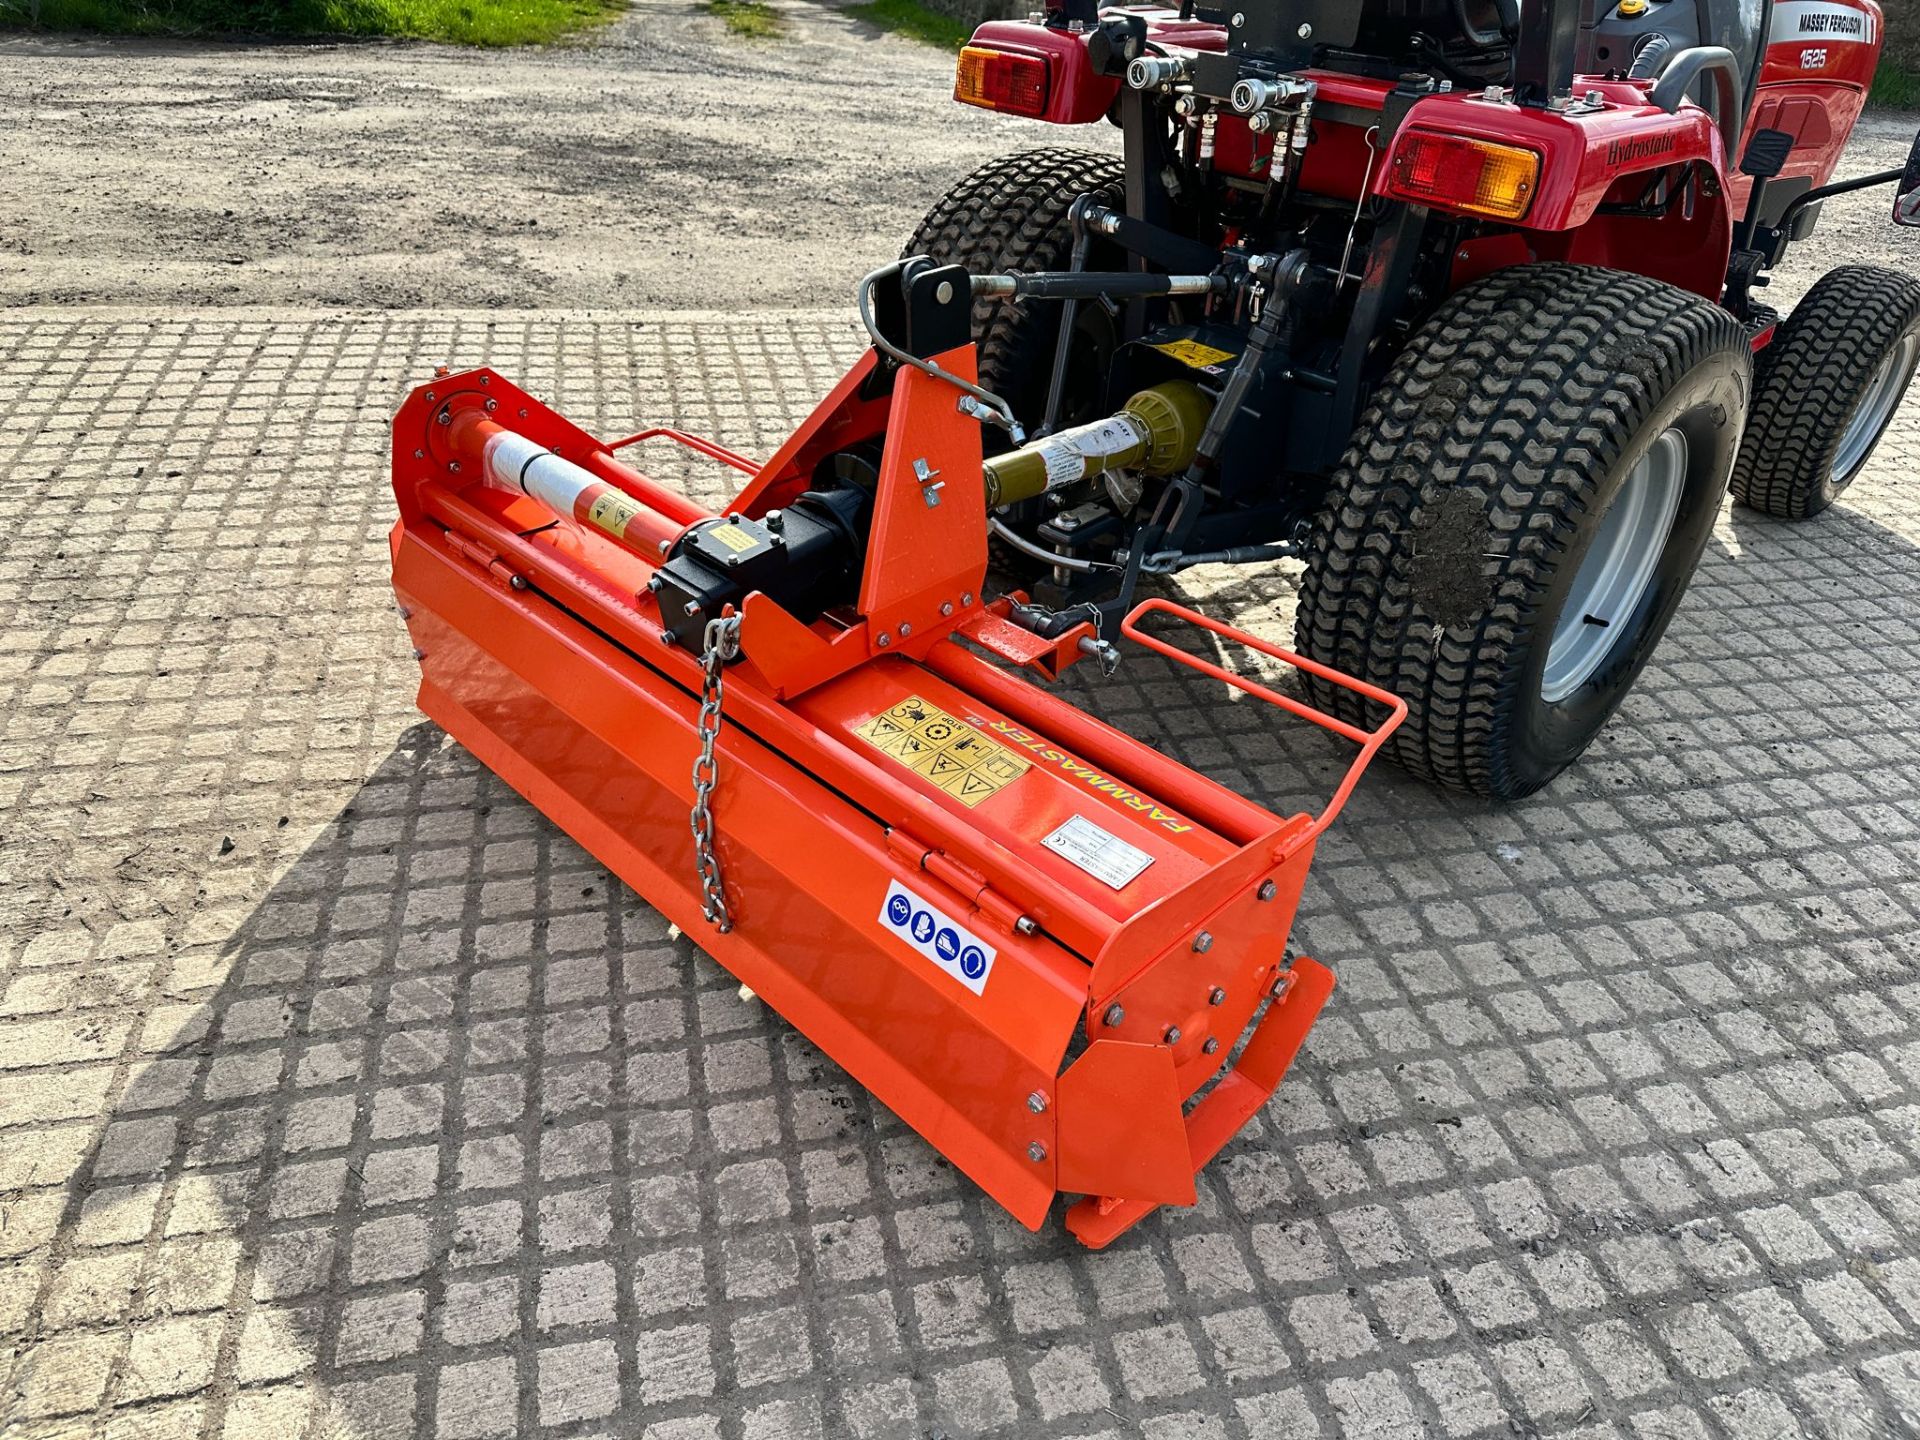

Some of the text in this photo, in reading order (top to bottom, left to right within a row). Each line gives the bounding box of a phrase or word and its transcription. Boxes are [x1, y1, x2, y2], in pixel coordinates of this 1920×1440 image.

[1799, 14, 1862, 35] MASSEY FERGUSON
[1800, 48, 1827, 69] 1525
[1607, 129, 1676, 169] Hydrostatic
[941, 717, 963, 730] STOP
[989, 721, 1193, 833] FARMMASTER
